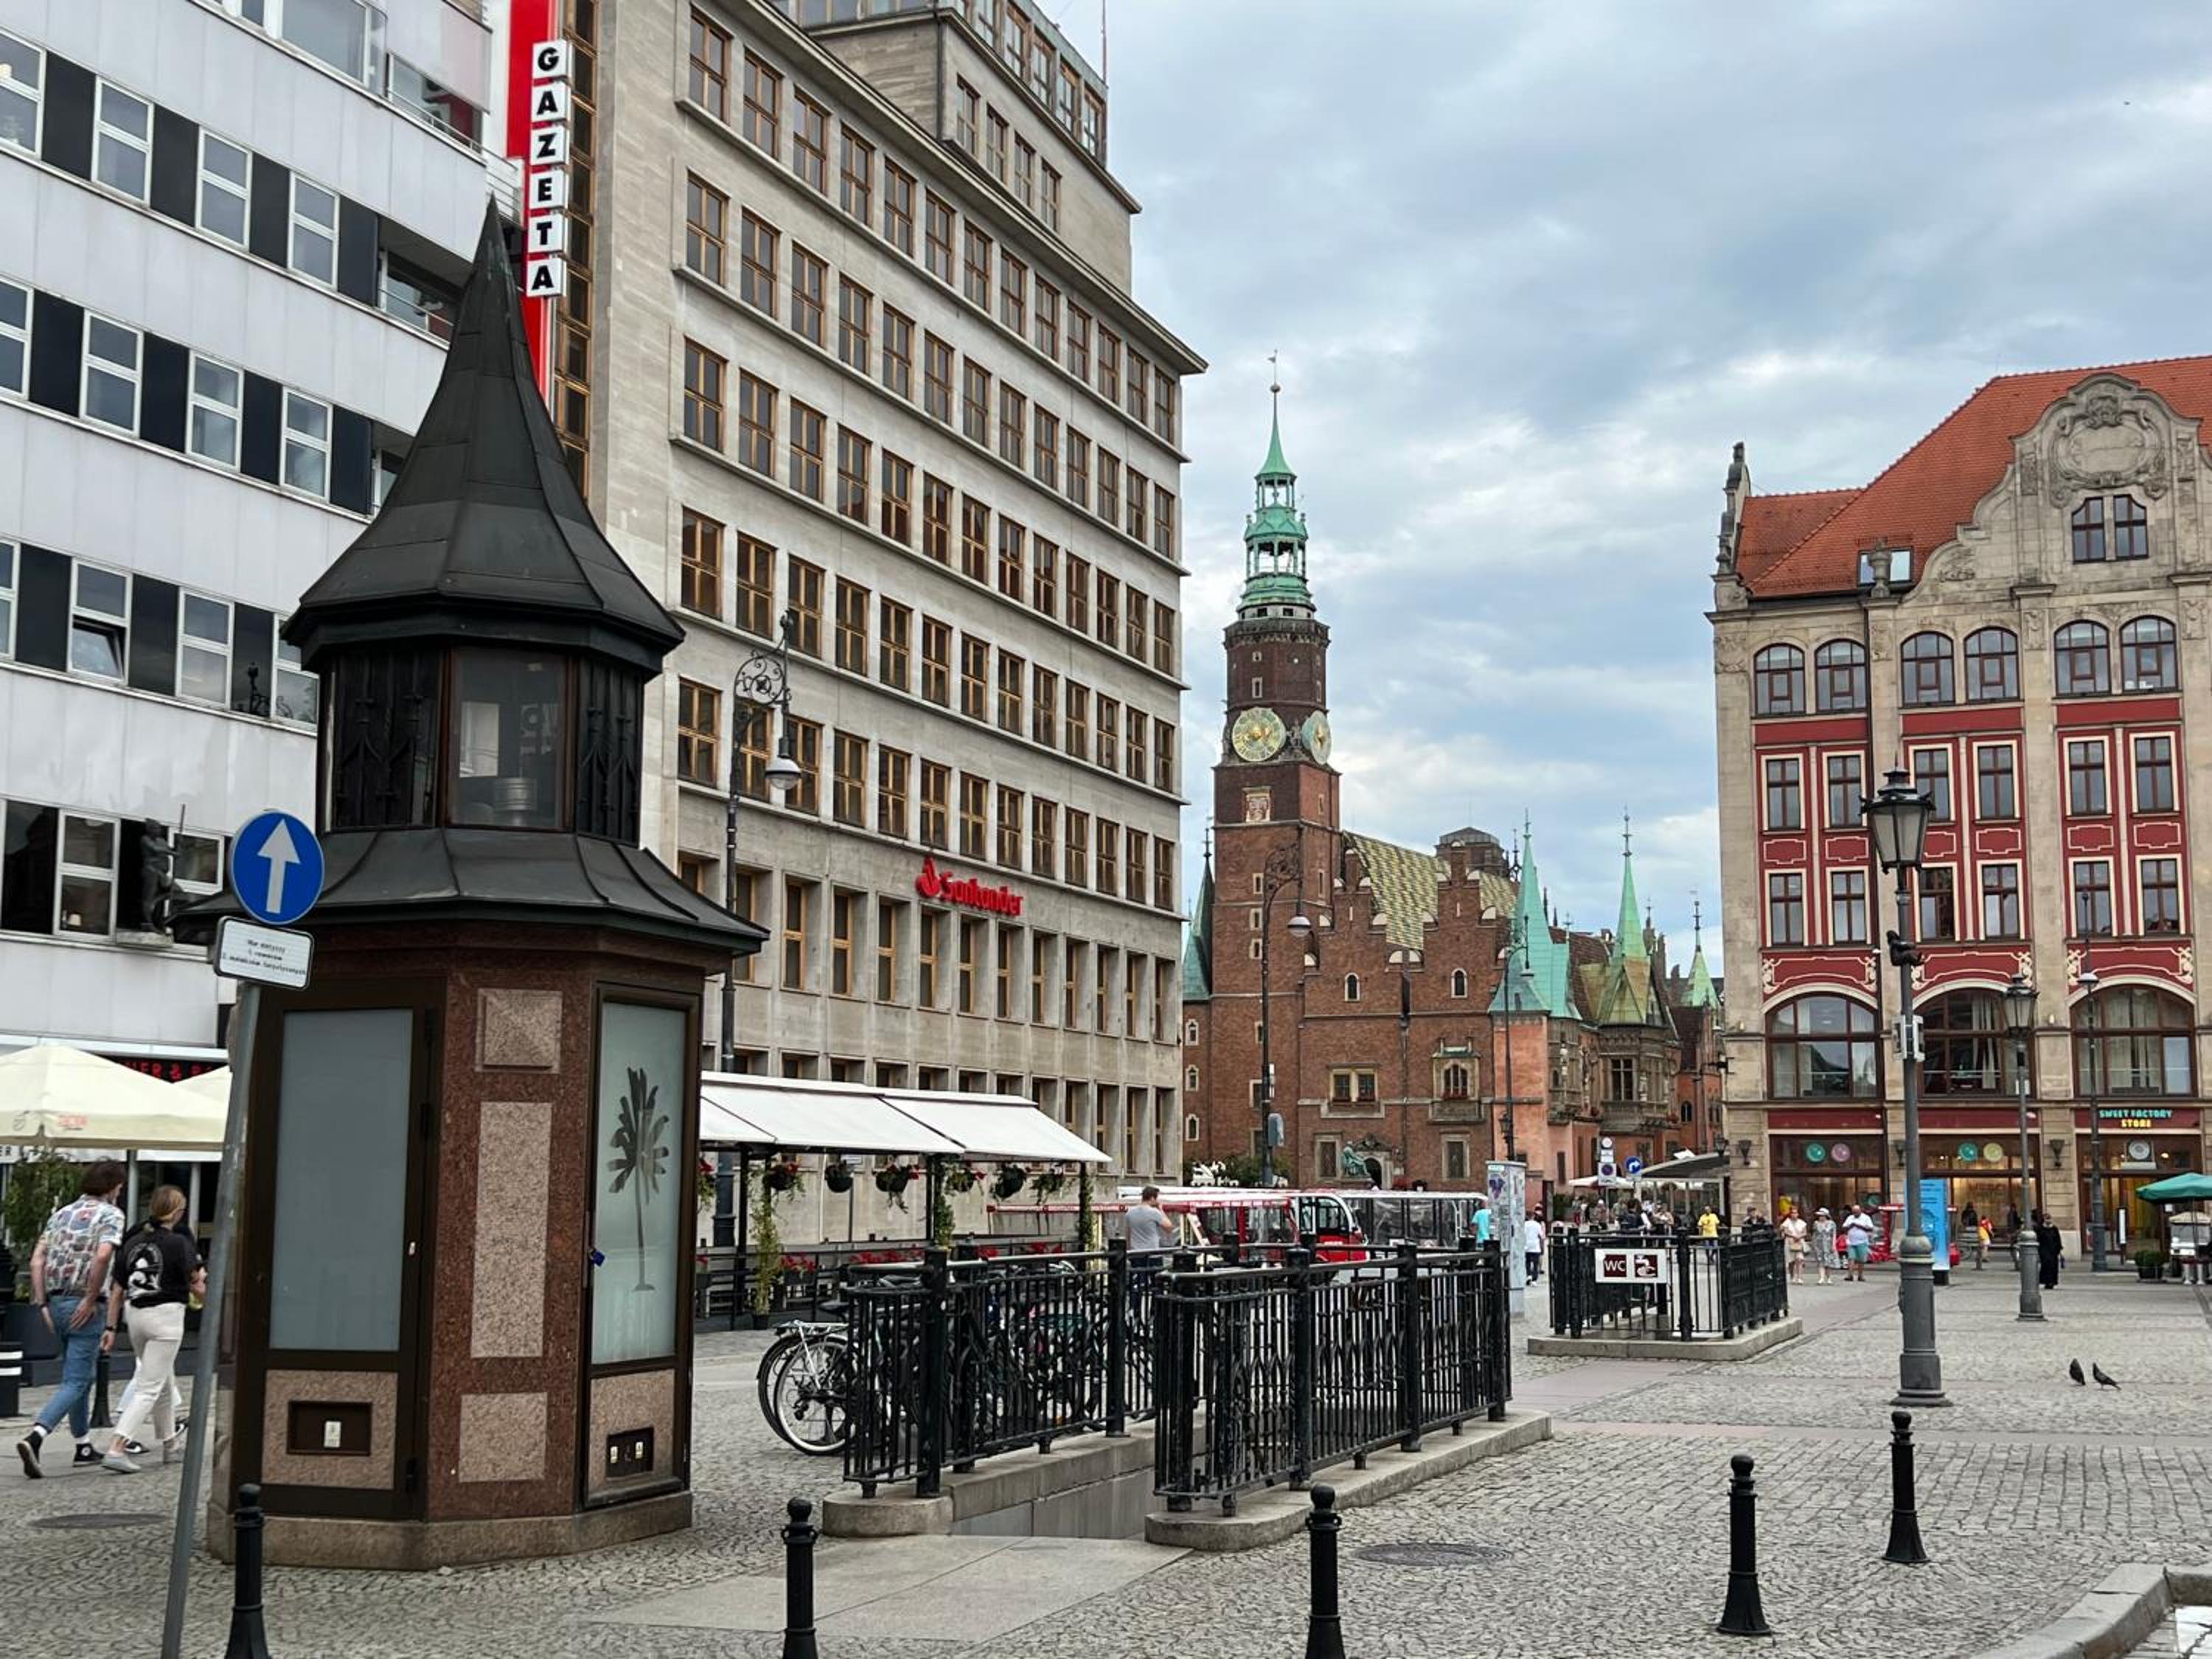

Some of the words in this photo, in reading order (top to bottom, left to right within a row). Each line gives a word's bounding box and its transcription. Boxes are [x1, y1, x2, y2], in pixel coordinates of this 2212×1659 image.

[532, 46, 559, 291] GAZETA
[939, 871, 1023, 916] Santander
[2099, 1109, 2129, 1119] SWEET
[2129, 1109, 2173, 1119] FACTORY
[2121, 1119, 2152, 1128] STORE
[1604, 1259, 1627, 1272] WC
